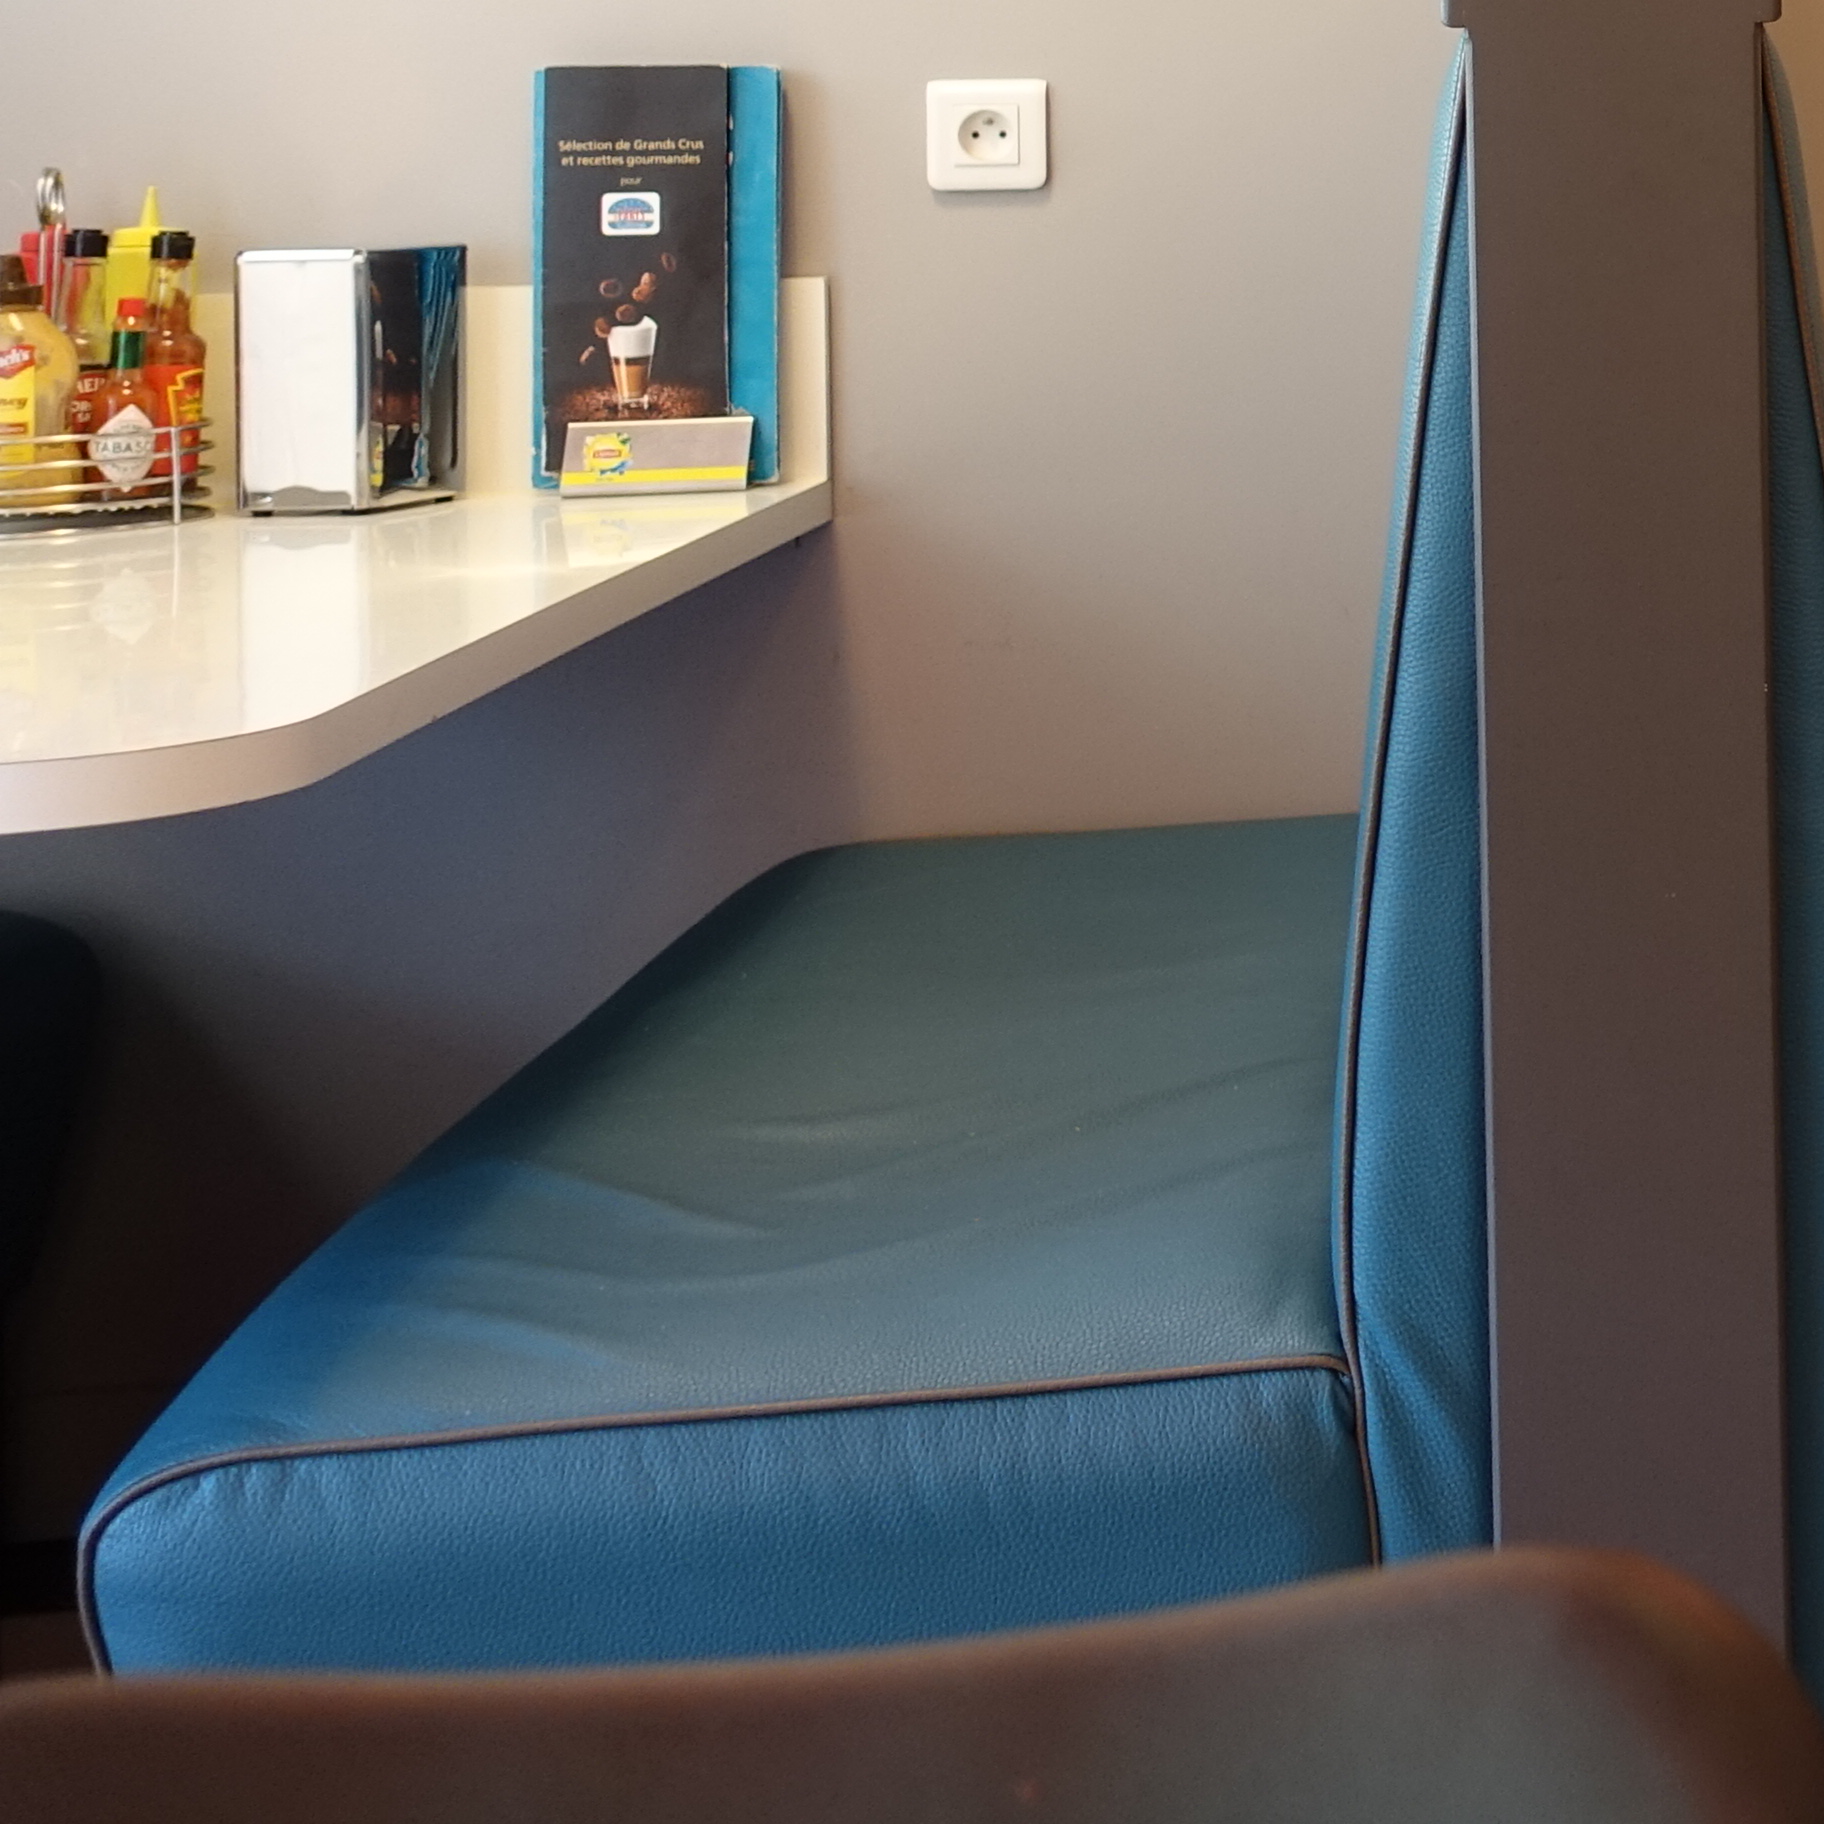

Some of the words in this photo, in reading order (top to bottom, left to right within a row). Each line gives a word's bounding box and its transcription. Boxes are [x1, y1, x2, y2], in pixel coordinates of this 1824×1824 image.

[559, 139, 612, 152] Sélection
[615, 138, 630, 151] de
[634, 138, 675, 151] Grands
[677, 138, 704, 150] Crus
[561, 155, 574, 166] et
[577, 154, 624, 166] recettes
[626, 153, 701, 167] gourmandes
